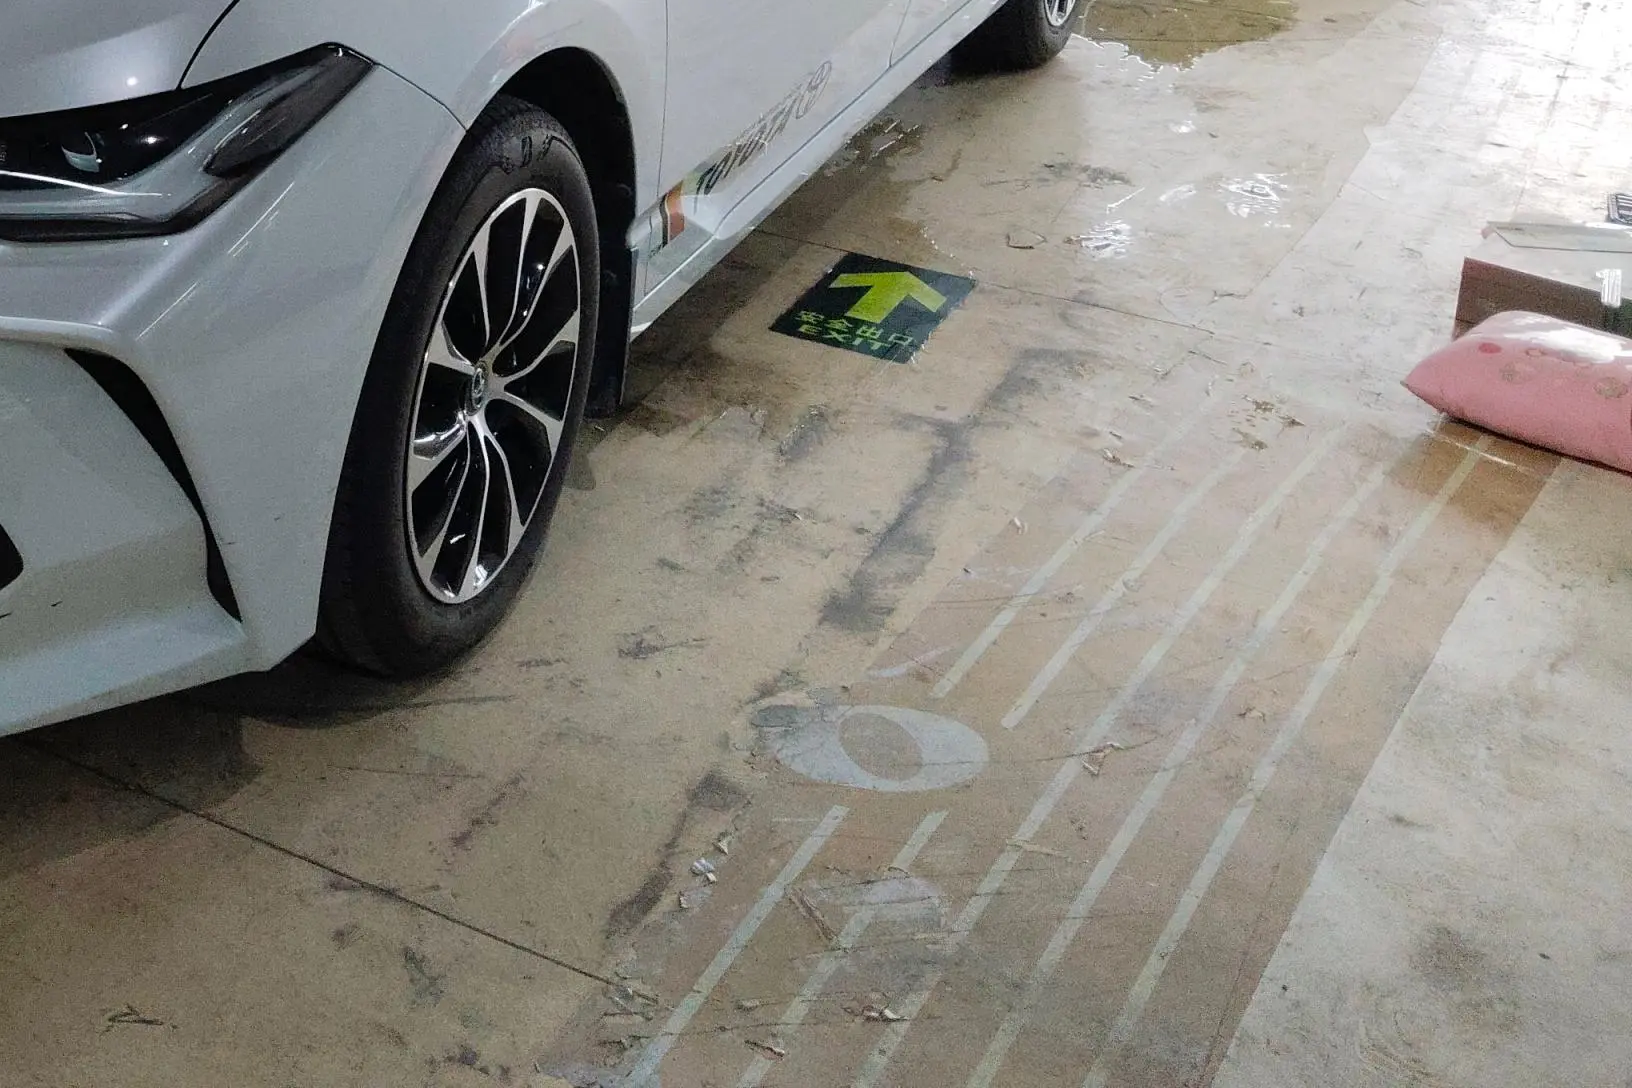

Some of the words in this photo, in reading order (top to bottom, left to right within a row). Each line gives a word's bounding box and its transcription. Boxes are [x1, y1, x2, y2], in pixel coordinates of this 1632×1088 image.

[792, 310, 914, 348] 安全出口
[797, 323, 891, 351] EXIT
